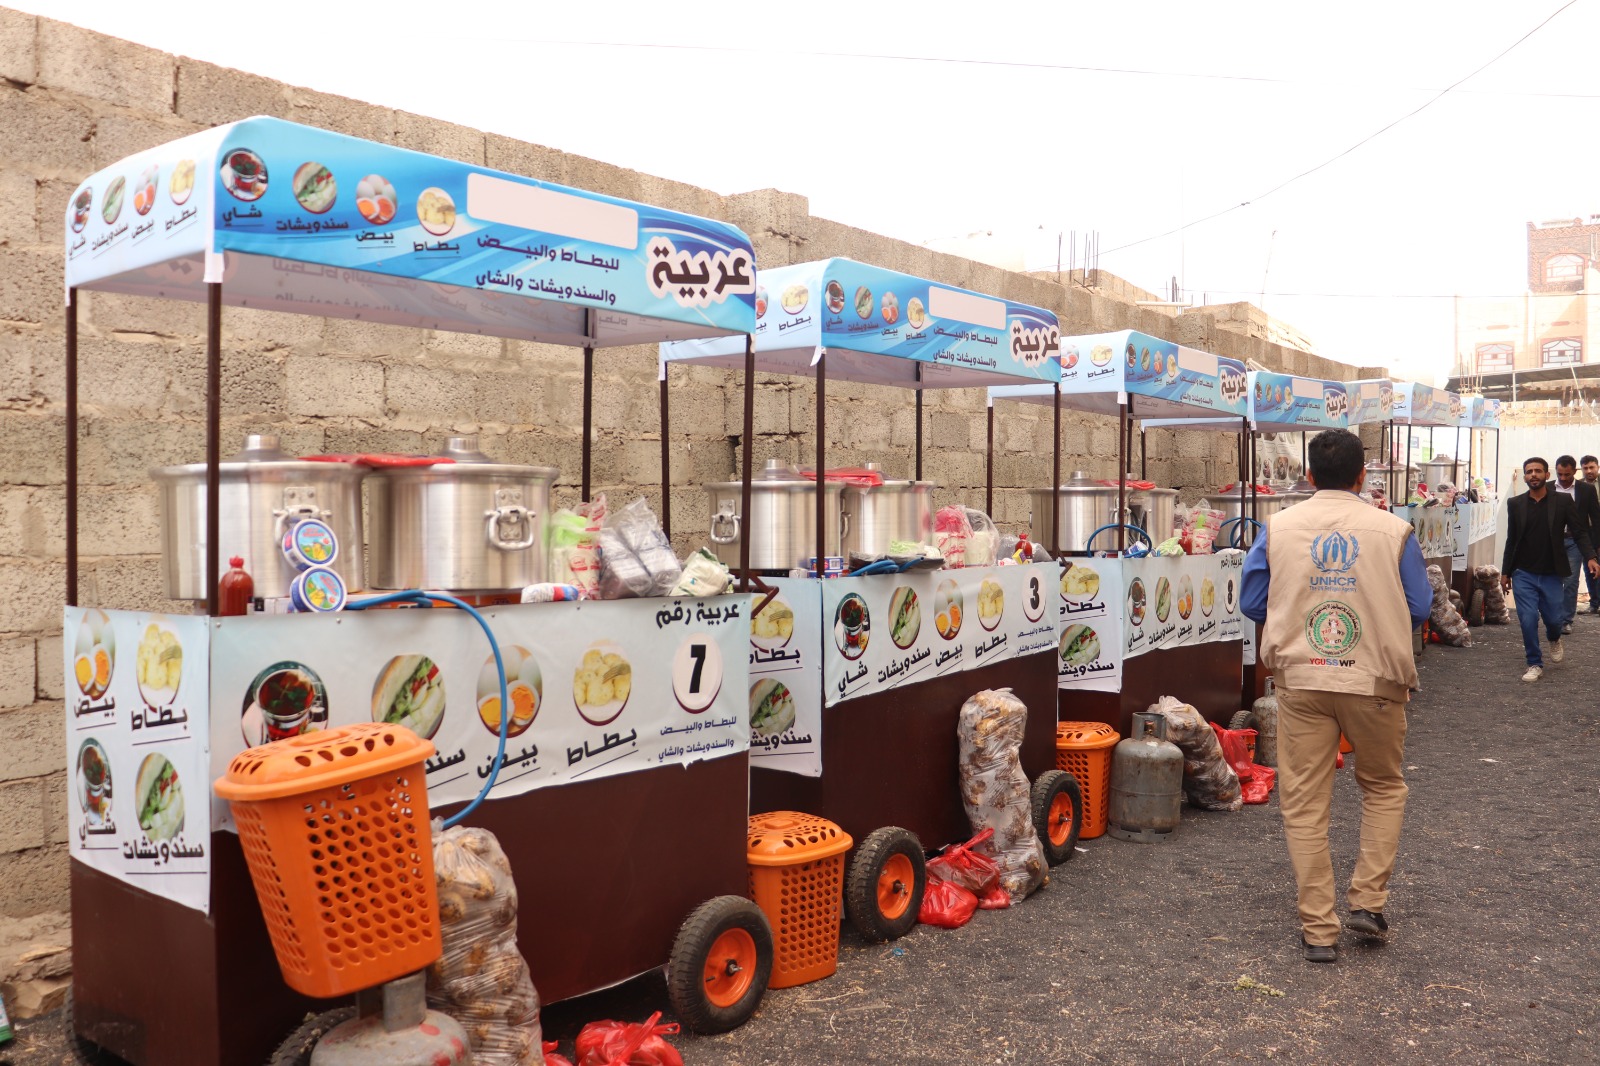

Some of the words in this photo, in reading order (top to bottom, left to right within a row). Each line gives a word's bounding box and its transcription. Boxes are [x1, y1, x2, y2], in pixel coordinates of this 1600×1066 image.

[164, 205, 198, 231] بطاط
[222, 204, 263, 228] شاي
[275, 214, 349, 232] سندويشات
[91, 222, 129, 252] سندويشات
[131, 219, 154, 238] بيض
[355, 229, 395, 243] بيض
[69, 233, 87, 257] شاي
[413, 240, 460, 252] بطاط
[476, 234, 556, 262] والبيض
[560, 247, 619, 271] للبطاط
[475, 270, 524, 290] والشاي
[652, 245, 750, 298] عربية
[528, 276, 616, 306] والسندويشات
[756, 321, 767, 330] بي
[778, 315, 812, 331] بطاط
[825, 317, 843, 330] شاي
[847, 322, 879, 333] سندويشات
[881, 327, 899, 336] بيض
[933, 325, 970, 342] والبيض
[905, 332, 927, 341] بطاط
[970, 331, 998, 345] للبطاط
[1013, 326, 1060, 361] عربية
[933, 349, 955, 364] والشاي
[956, 352, 997, 368] والسندويشات
[1087, 367, 1115, 378] بطاط
[1221, 374, 1247, 400] عربية
[1325, 395, 1347, 417] عربية
[1227, 579, 1234, 605] 8
[1310, 576, 1357, 586] UNHCR
[1029, 576, 1040, 611] 3
[655, 599, 692, 629] رقم
[695, 600, 740, 626] عربية
[1148, 623, 1176, 645] سندويشات
[1177, 623, 1193, 639] بيض
[1198, 619, 1216, 636] بطاط
[974, 632, 1007, 658] بطاط
[1127, 628, 1145, 653] شاي
[877, 646, 931, 684] سندويشات
[935, 643, 963, 667] بيض
[1310, 658, 1339, 666] YGUSS
[1339, 659, 1356, 667] WP
[689, 644, 707, 694] 7
[838, 660, 868, 699] شاي
[1058, 661, 1115, 678] سندويش
[74, 696, 116, 718] بيض
[130, 706, 188, 732] بطاط
[660, 721, 703, 736] والبيض
[704, 716, 737, 730] للبطاط
[566, 727, 638, 766] بطاط
[686, 738, 735, 755] والسندويشات
[749, 730, 812, 751] سندويش
[477, 743, 539, 779] بيض
[658, 744, 684, 763] والشاي
[79, 811, 117, 850] شاي
[123, 837, 205, 867] سندويشات
